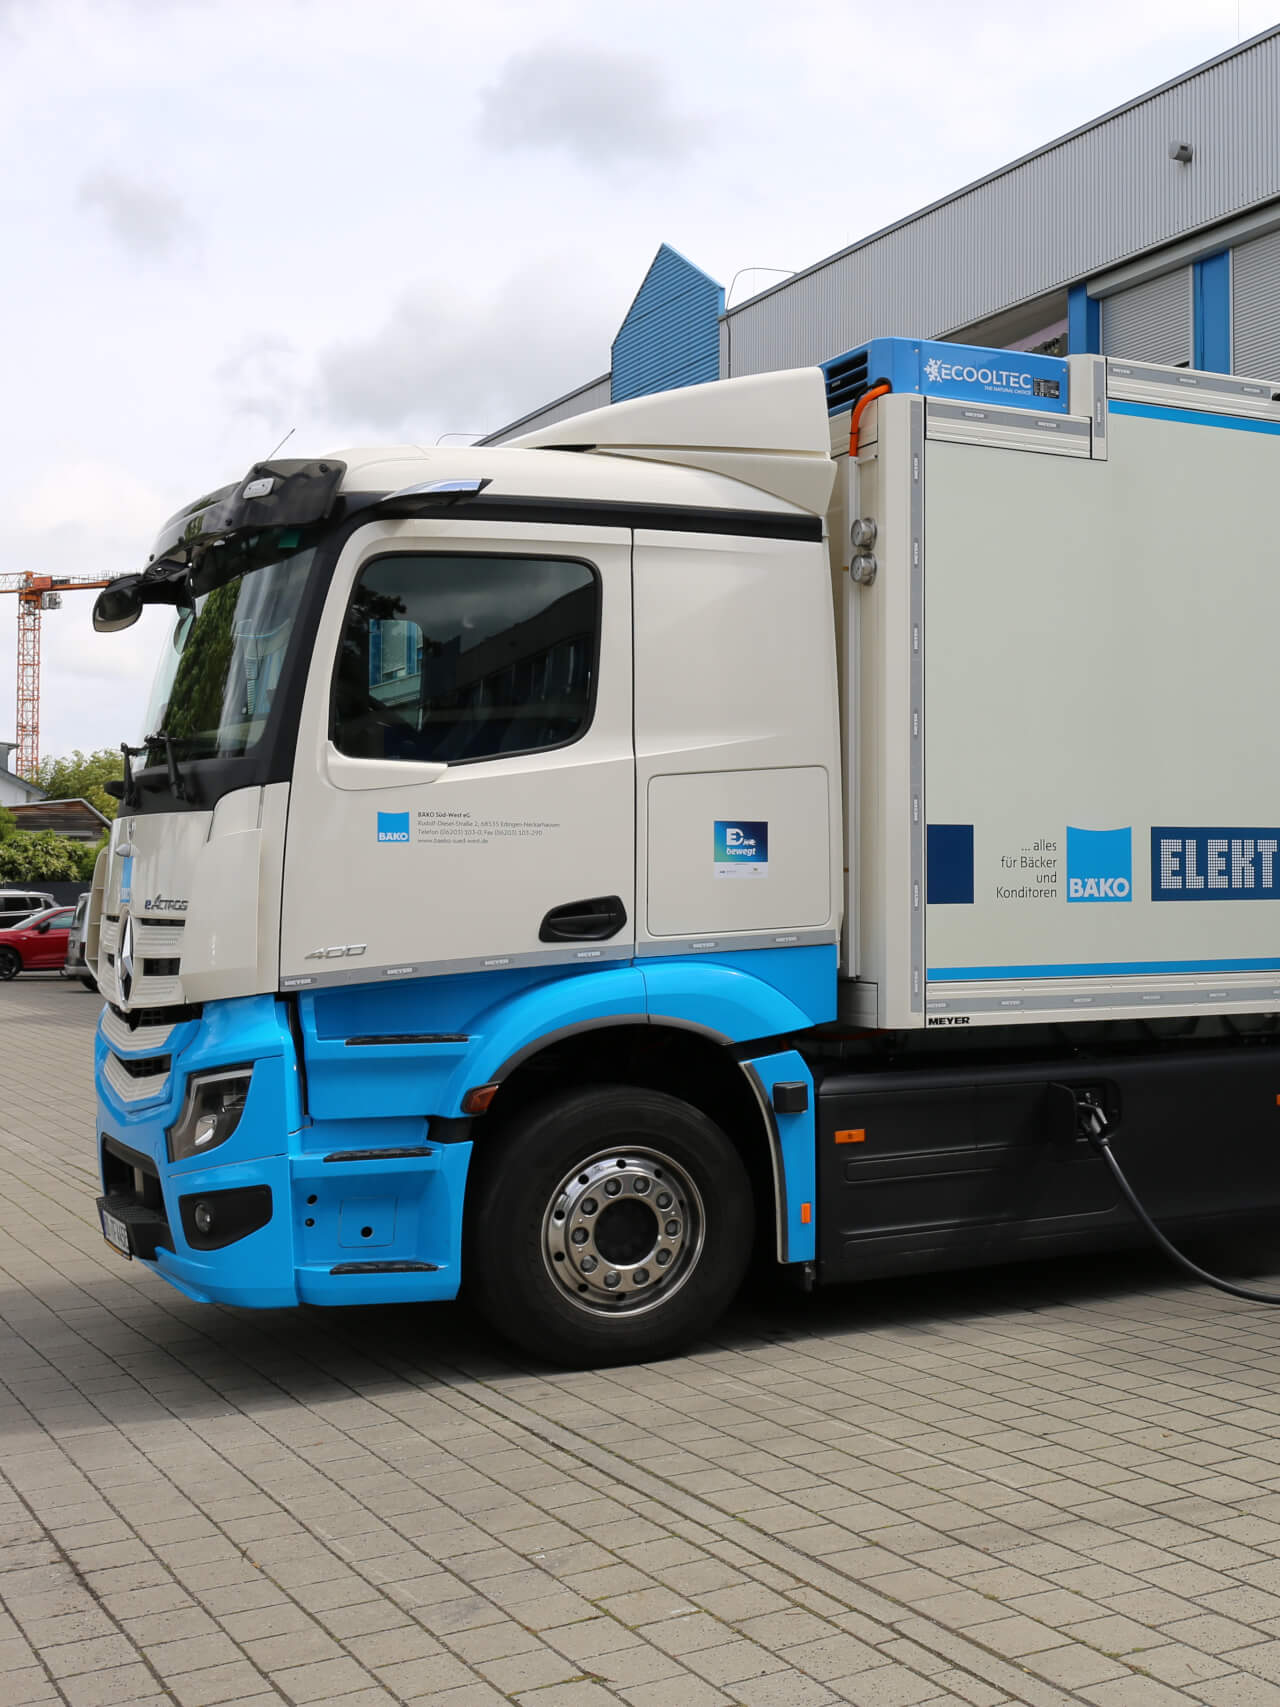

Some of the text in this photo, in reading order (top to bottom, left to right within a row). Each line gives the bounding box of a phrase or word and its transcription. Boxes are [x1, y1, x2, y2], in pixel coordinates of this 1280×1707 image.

[941, 364, 1032, 389] ECOOLTEC
[379, 832, 409, 841] BÄKO
[1033, 839, 1057, 851] alles
[726, 847, 756, 857] bewegt
[1001, 856, 1057, 868] für Bäcker
[1036, 871, 1057, 883] und
[996, 887, 1057, 899] Konditoren
[1069, 877, 1130, 898] BÄKO
[304, 944, 367, 960] 400
[928, 1016, 970, 1026] MEYER
